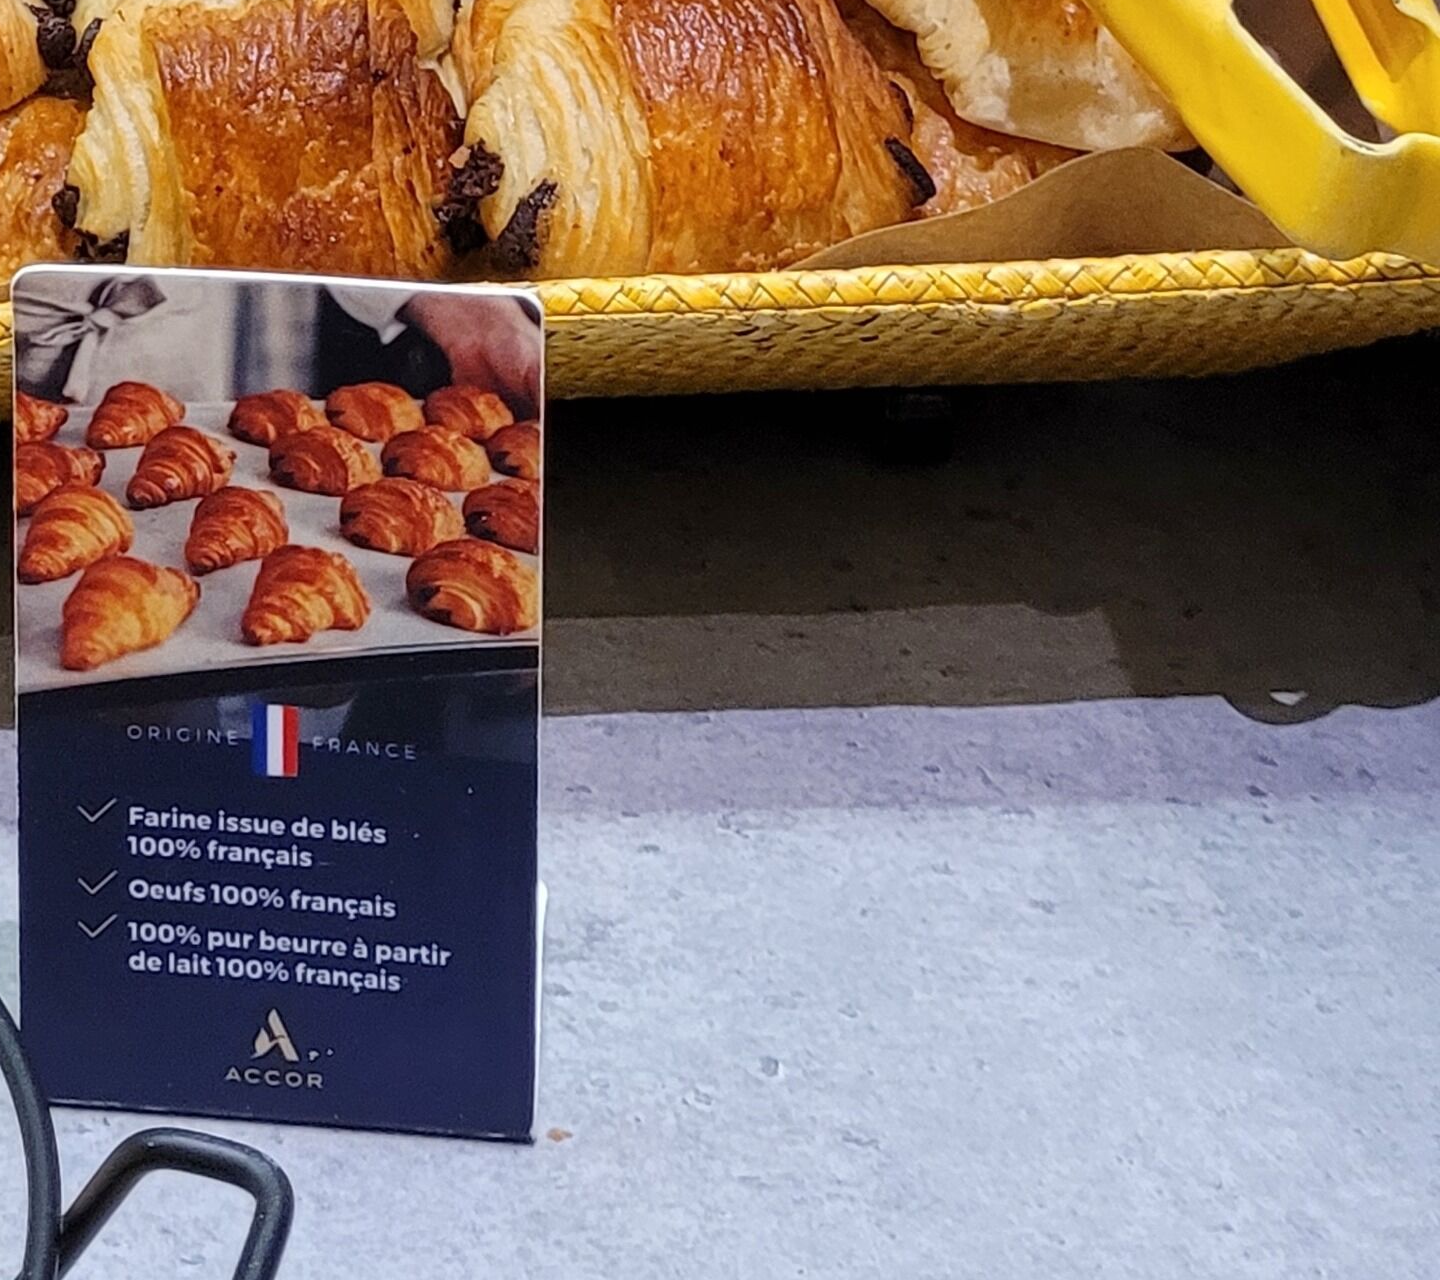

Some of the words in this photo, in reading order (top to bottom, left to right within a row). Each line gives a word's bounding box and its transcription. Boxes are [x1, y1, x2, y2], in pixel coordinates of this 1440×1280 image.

[126, 724, 240, 747] ORIGINE
[311, 735, 418, 762] FRANCE
[127, 805, 212, 832] Farine
[217, 809, 286, 837] issue
[291, 817, 326, 840] de
[331, 818, 388, 845] blés
[126, 835, 202, 861] 100%
[206, 838, 314, 871] français
[127, 878, 206, 904] Oeufs
[210, 883, 285, 910] 100%
[290, 888, 397, 921] français
[126, 921, 202, 946] 100%
[206, 929, 254, 952] pur
[258, 929, 348, 958] beurre
[352, 936, 370, 960] à
[374, 941, 452, 968] partir
[127, 950, 163, 973] de
[167, 951, 211, 977] lait
[215, 956, 290, 983] 100%
[295, 962, 402, 994] français
[223, 1065, 325, 1090] ACCOR
